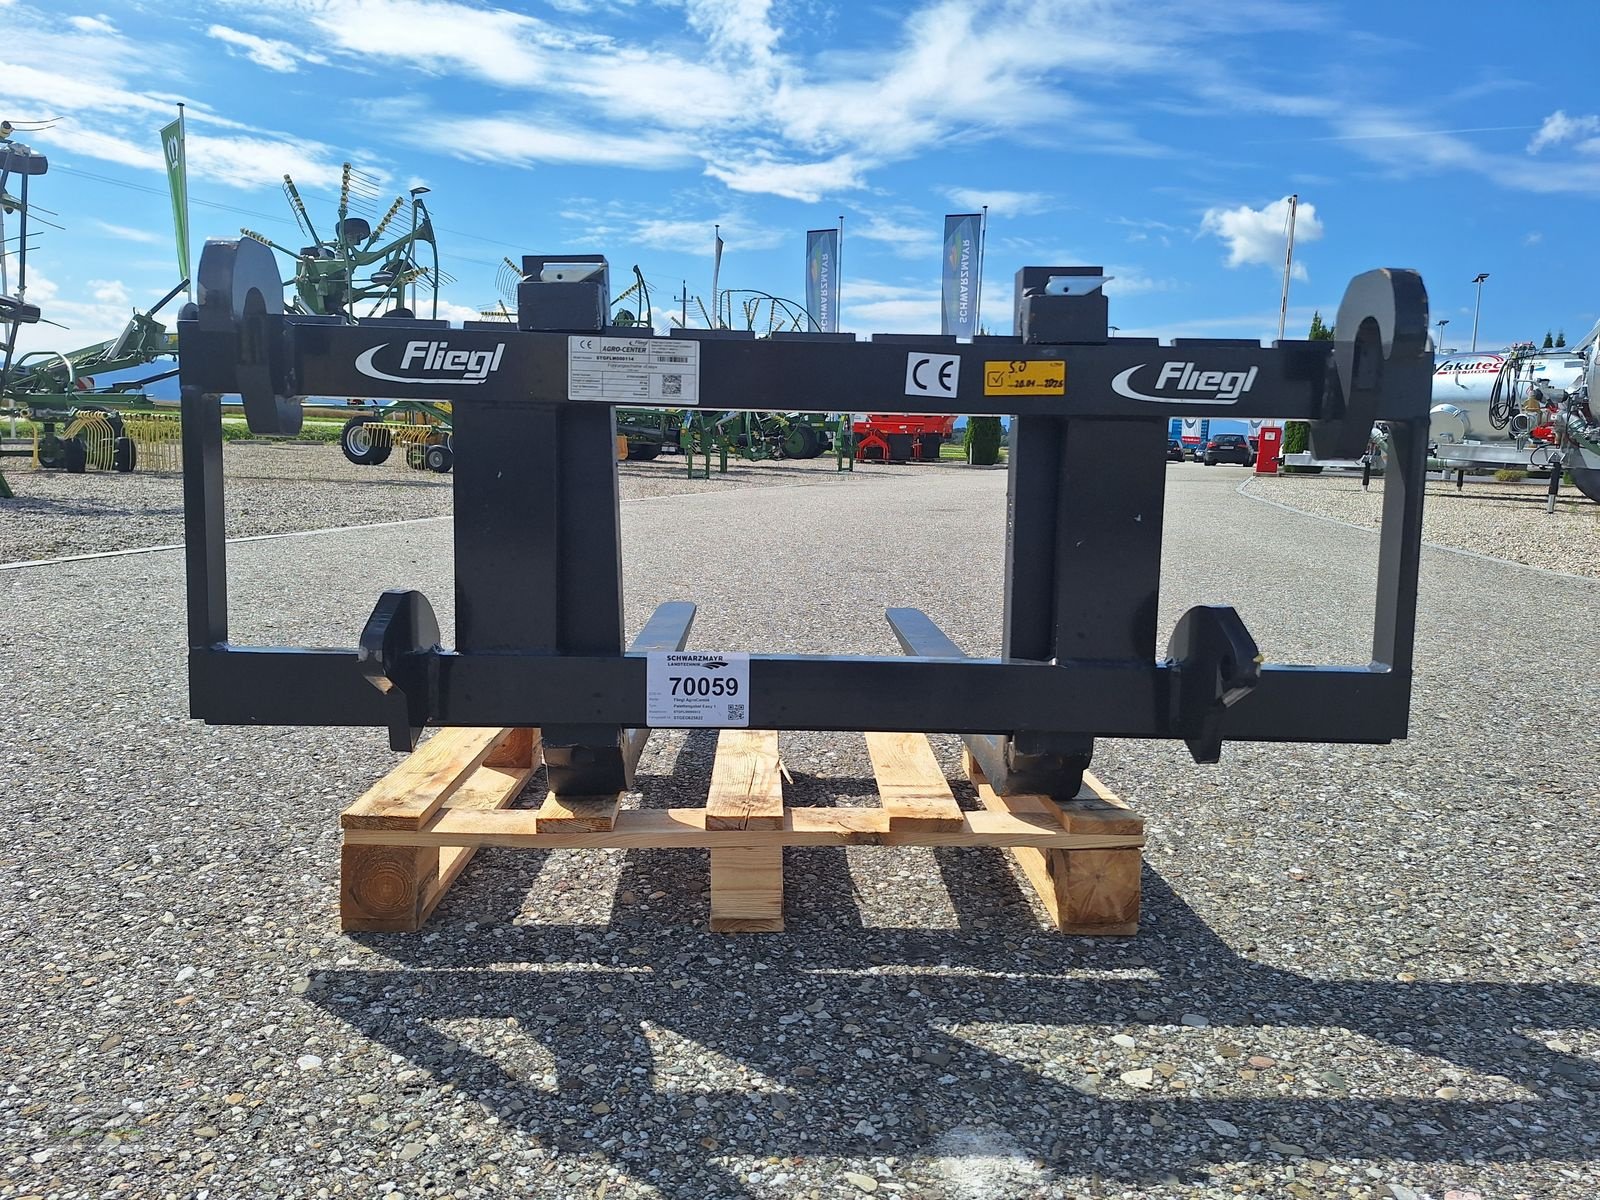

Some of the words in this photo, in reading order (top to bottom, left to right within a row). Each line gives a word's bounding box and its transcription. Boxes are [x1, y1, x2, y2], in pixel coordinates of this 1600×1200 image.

[399, 340, 506, 379] Fliegl
[602, 345, 647, 354] AGRO-CENTER
[912, 358, 955, 392] CE
[1154, 361, 1259, 400] Fliegl
[669, 677, 739, 697] 70059
